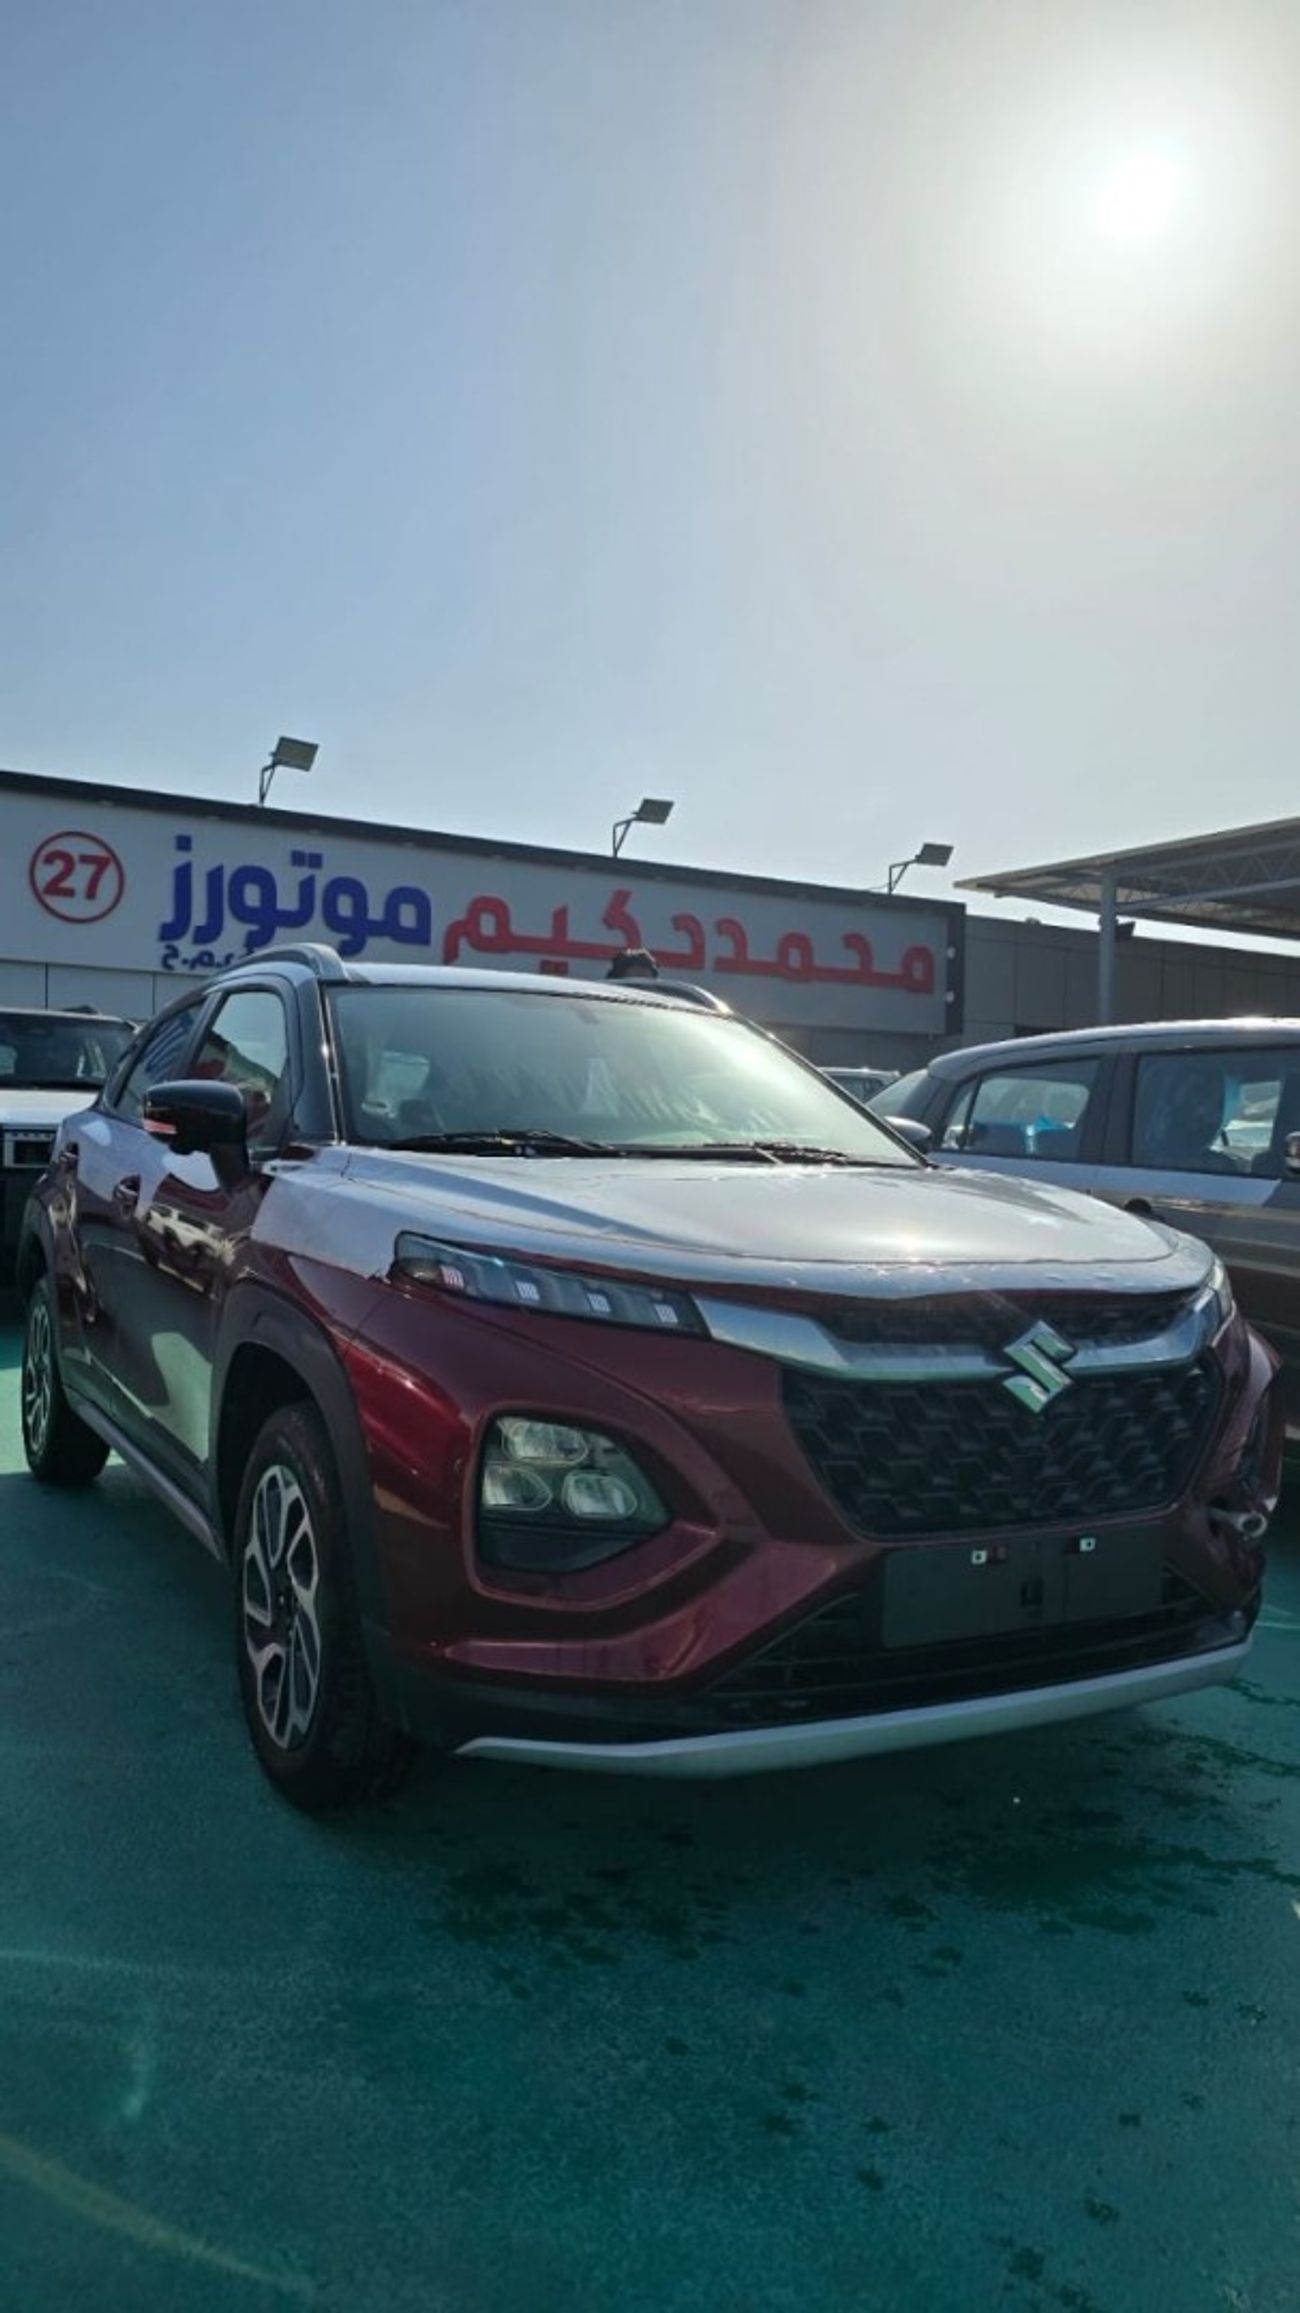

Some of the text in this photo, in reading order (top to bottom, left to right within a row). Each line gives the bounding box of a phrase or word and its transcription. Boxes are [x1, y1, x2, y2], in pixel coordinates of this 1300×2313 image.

[42, 850, 111, 901] 27
[159, 834, 934, 994] محمد حكيم موتورز
